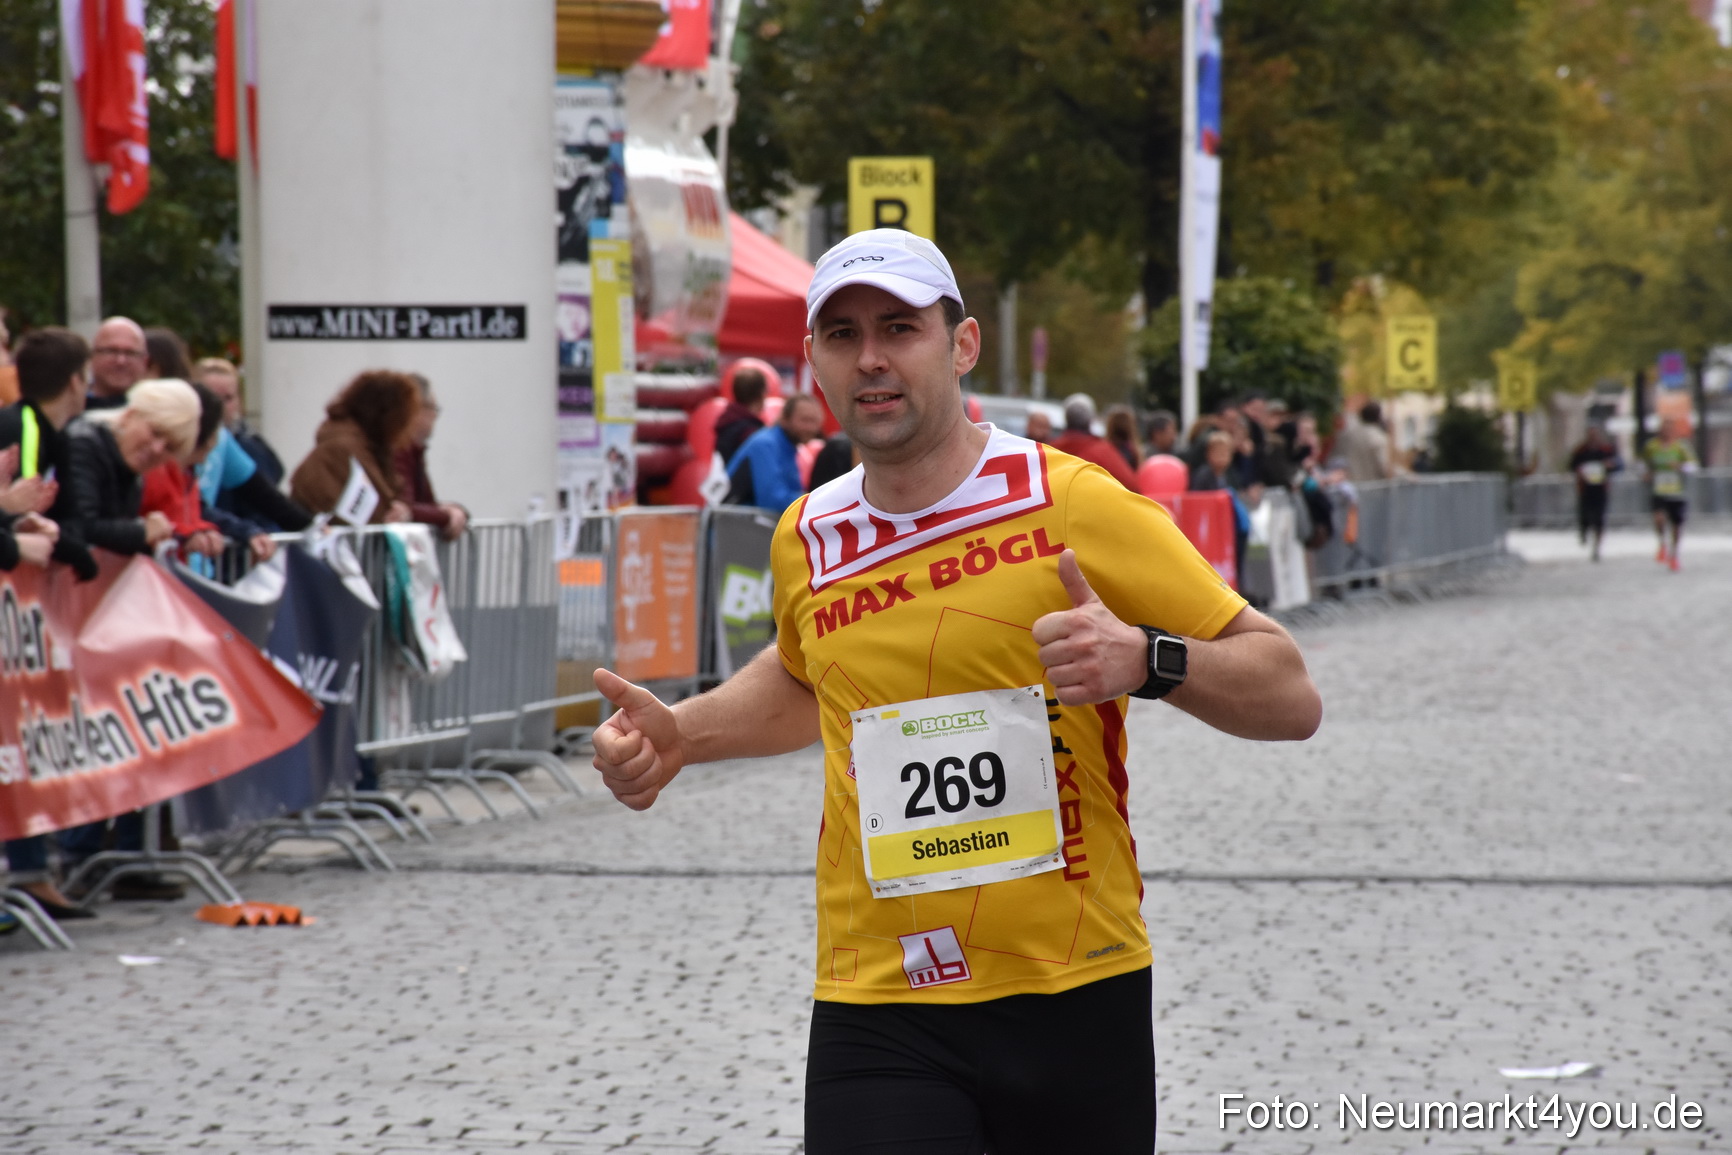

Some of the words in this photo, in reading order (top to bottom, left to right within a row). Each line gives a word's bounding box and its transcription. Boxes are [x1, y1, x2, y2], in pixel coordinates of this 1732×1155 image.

[860, 164, 922, 187] Block
[842, 255, 885, 268] orca
[1399, 338, 1422, 371] C
[813, 572, 917, 639] MAX
[928, 527, 1066, 590] BÖGL
[124, 673, 229, 748] Hits
[920, 710, 988, 734] BOCK
[921, 732, 942, 740] inspired
[966, 726, 990, 735] concepts
[901, 751, 1006, 819] 269
[871, 818, 878, 829] D
[912, 830, 1010, 860] Sebastian
